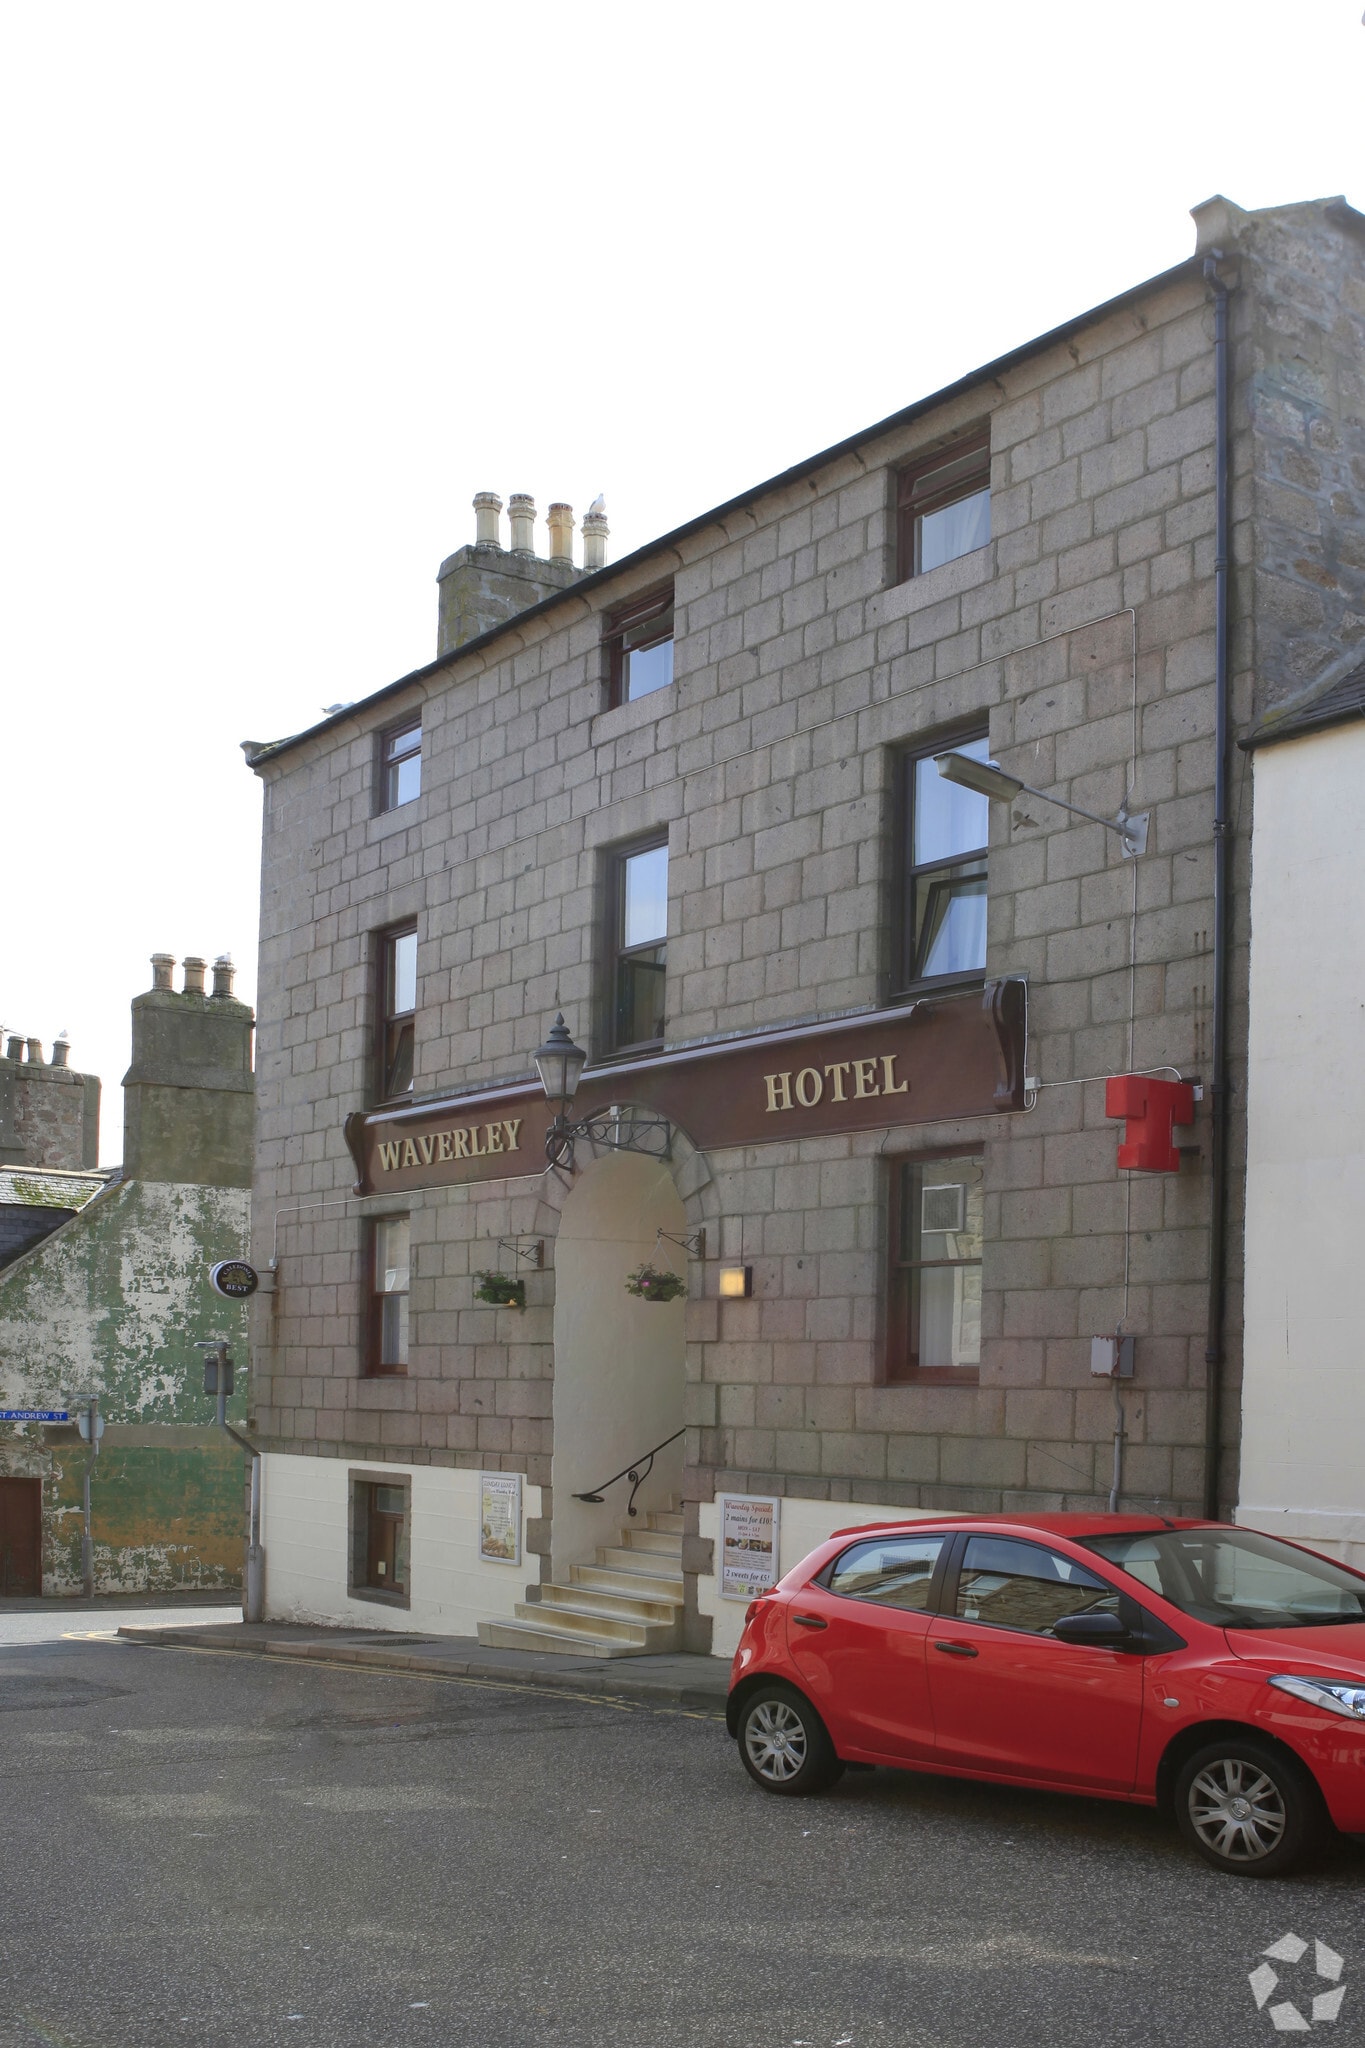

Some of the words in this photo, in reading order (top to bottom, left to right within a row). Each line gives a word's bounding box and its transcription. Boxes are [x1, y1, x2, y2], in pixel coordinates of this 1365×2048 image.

[377, 1118, 522, 1171] WAVERLEY
[763, 1054, 909, 1112] HOTEL
[226, 1284, 248, 1292] BEST
[725, 1502, 750, 1513] Waverley
[751, 1504, 773, 1514] Specials
[725, 1513, 730, 1521] 2
[730, 1514, 748, 1523] mains
[748, 1515, 758, 1526] for
[759, 1517, 772, 1525] £10!
[726, 1569, 730, 1577] 2
[730, 1570, 749, 1580] sweets
[749, 1571, 759, 1581] for
[760, 1573, 770, 1582] £5!
